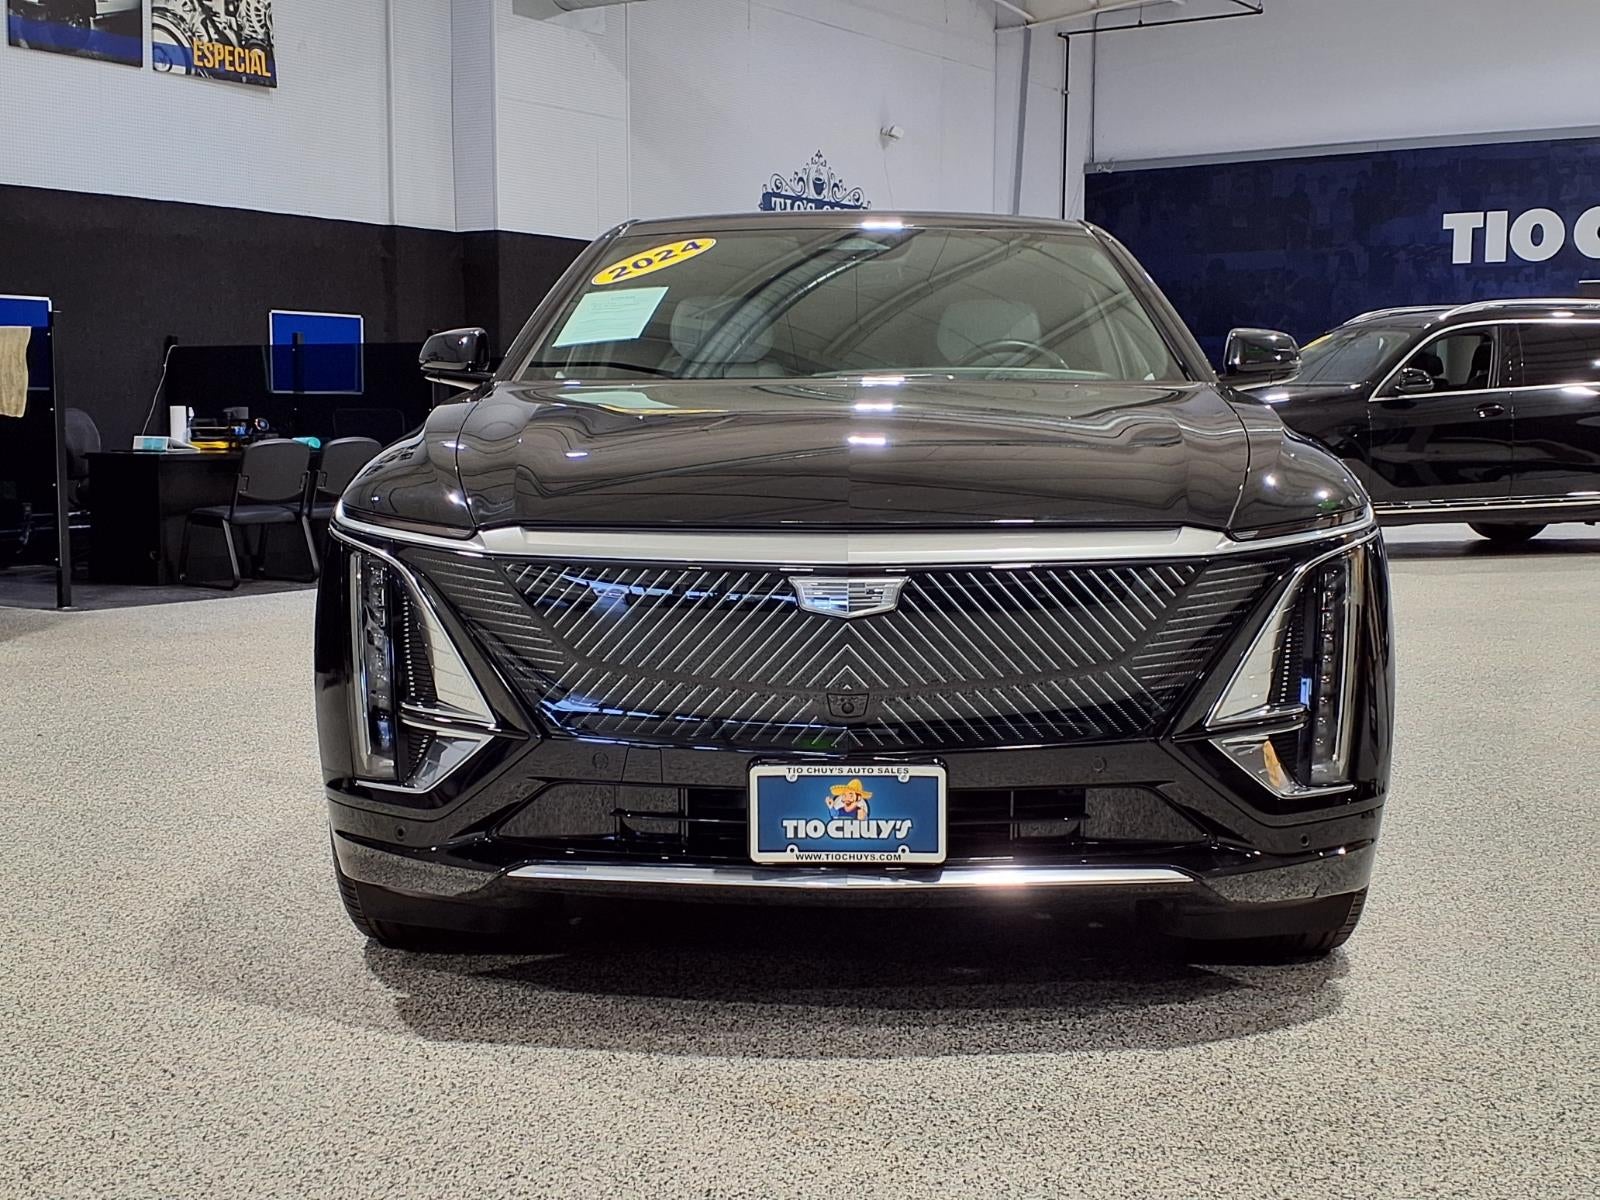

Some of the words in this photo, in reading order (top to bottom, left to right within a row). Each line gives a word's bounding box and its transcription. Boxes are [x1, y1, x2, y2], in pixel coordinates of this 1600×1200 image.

[193, 38, 271, 77] ESPECIAL
[1443, 208, 1566, 264] TIO
[608, 241, 703, 280] 2024
[795, 853, 901, 861] WWW.TIOCHUYS.COM
